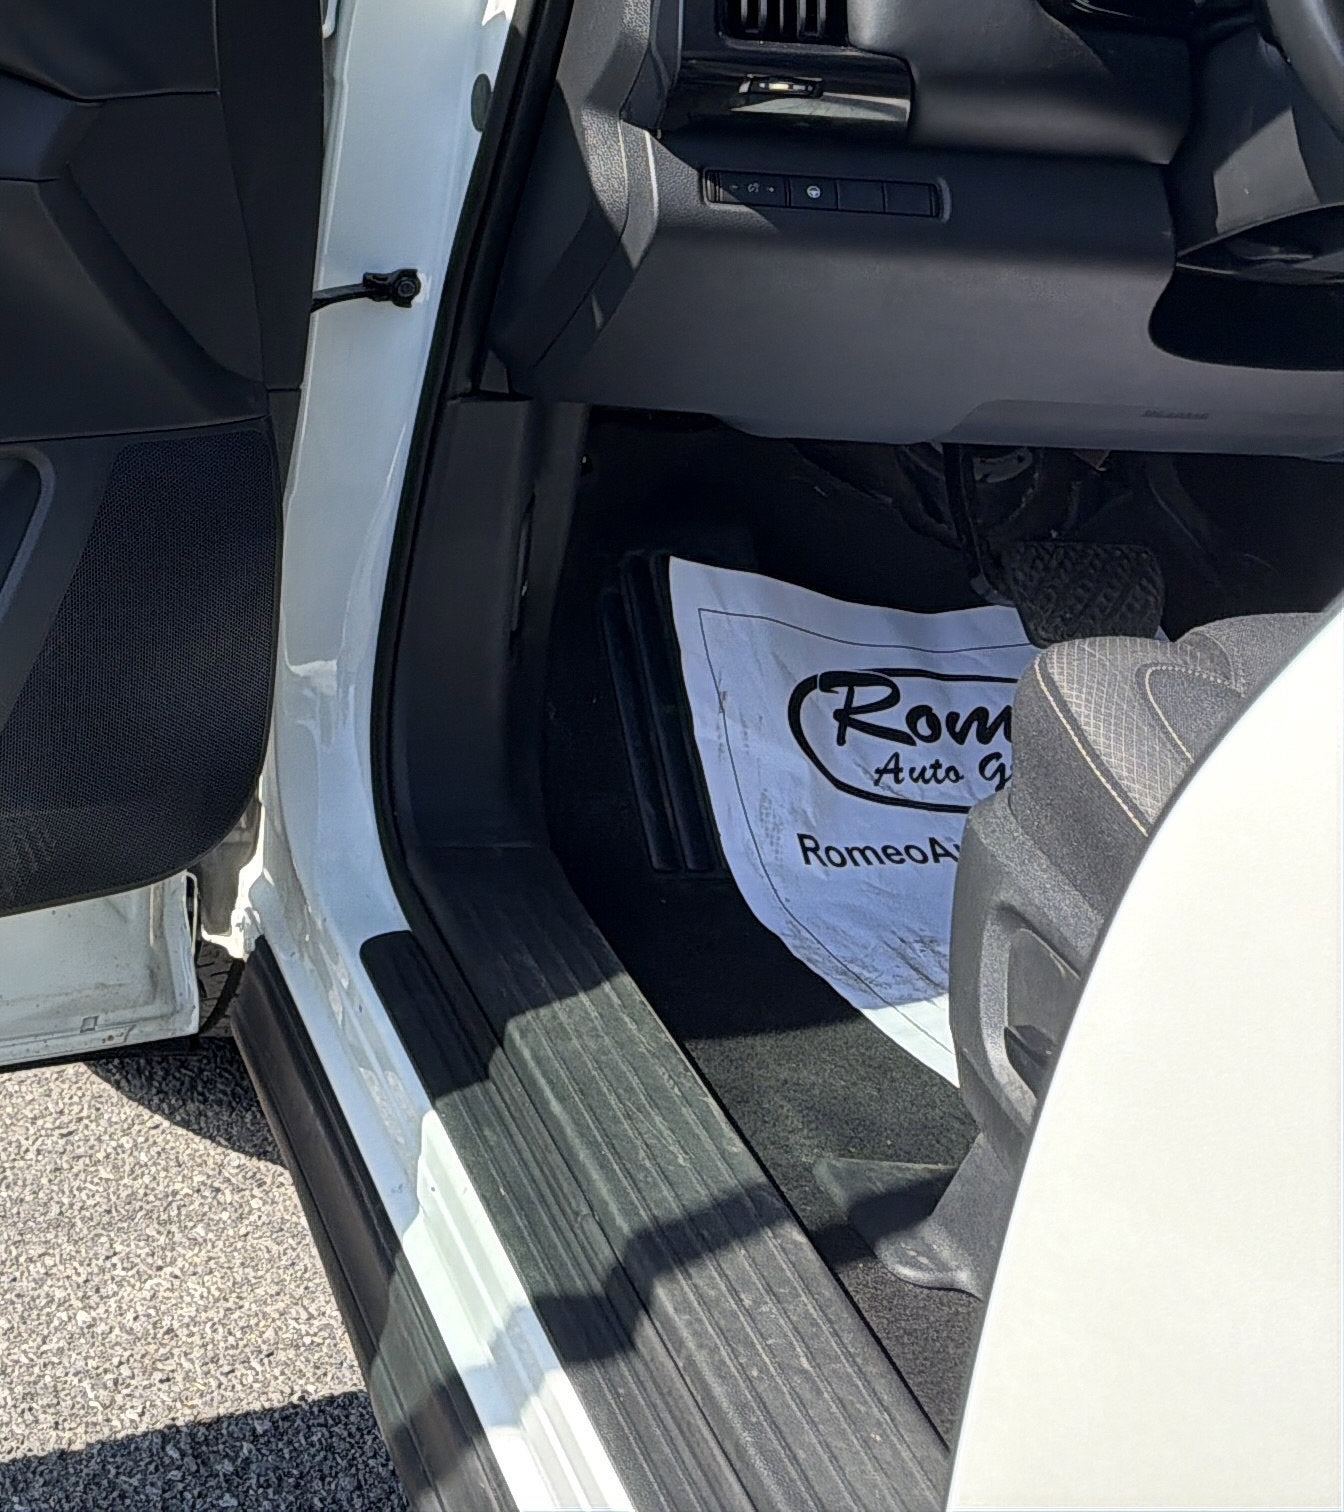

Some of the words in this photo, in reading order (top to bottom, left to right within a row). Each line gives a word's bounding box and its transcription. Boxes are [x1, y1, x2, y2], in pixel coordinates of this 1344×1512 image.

[873, 751, 964, 787] Auto
[978, 751, 1013, 793] G
[797, 833, 960, 868] RomeoA
